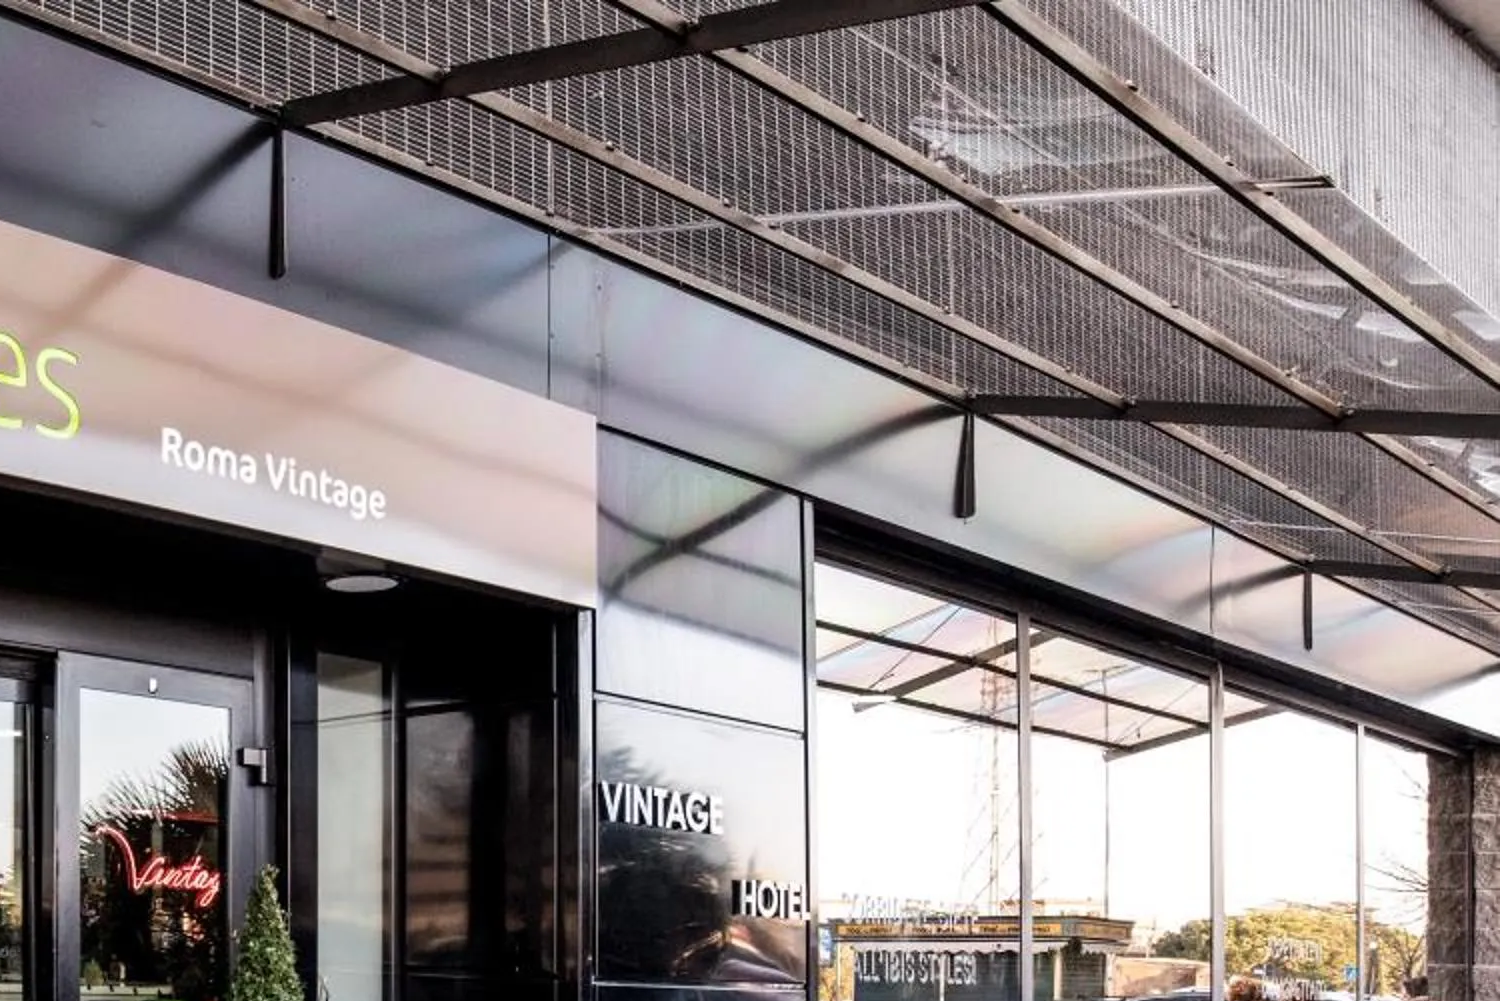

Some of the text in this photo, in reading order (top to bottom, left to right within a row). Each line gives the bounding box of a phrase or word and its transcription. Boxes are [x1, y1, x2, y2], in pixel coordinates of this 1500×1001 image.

[161, 426, 387, 521] Roma Vintage
[601, 779, 725, 836] VINTAGE
[739, 879, 810, 921] HOTEL
